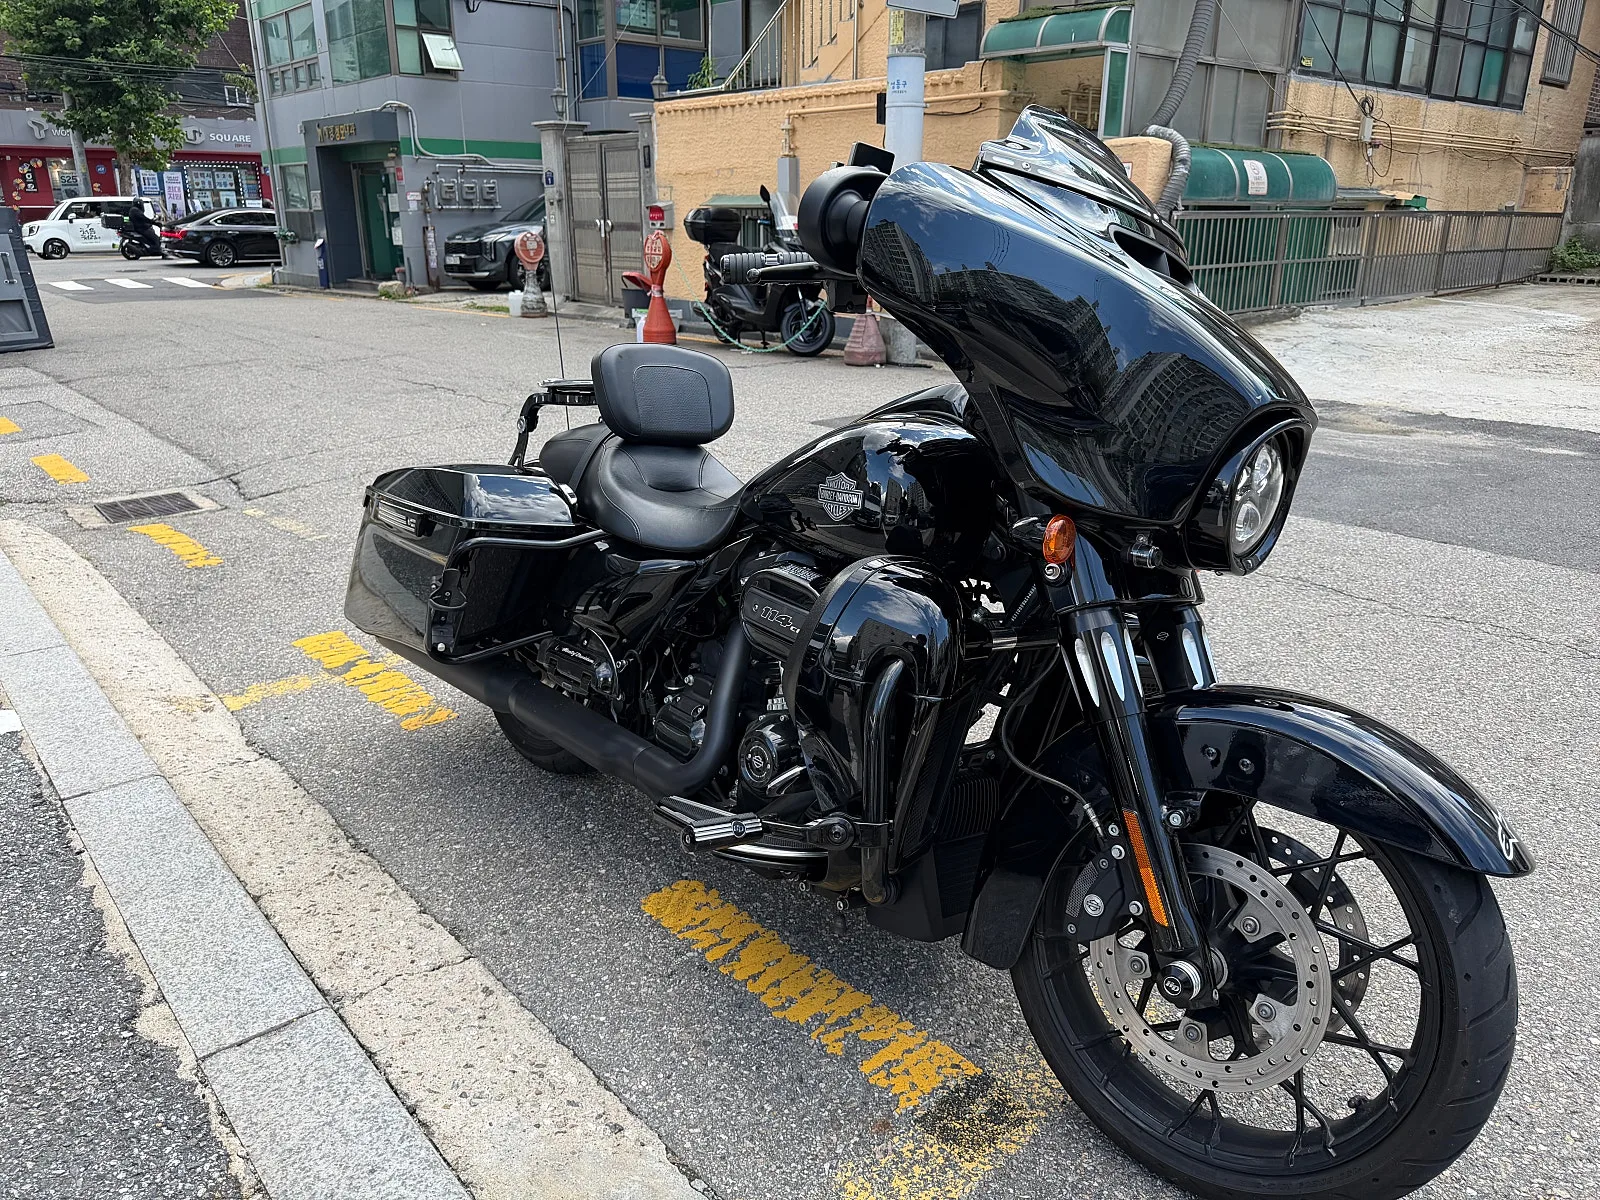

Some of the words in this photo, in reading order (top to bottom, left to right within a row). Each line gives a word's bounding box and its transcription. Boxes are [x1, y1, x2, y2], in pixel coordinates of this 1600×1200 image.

[209, 133, 252, 143] SQUARE
[60, 175, 78, 184] S25
[761, 606, 793, 627] 114
